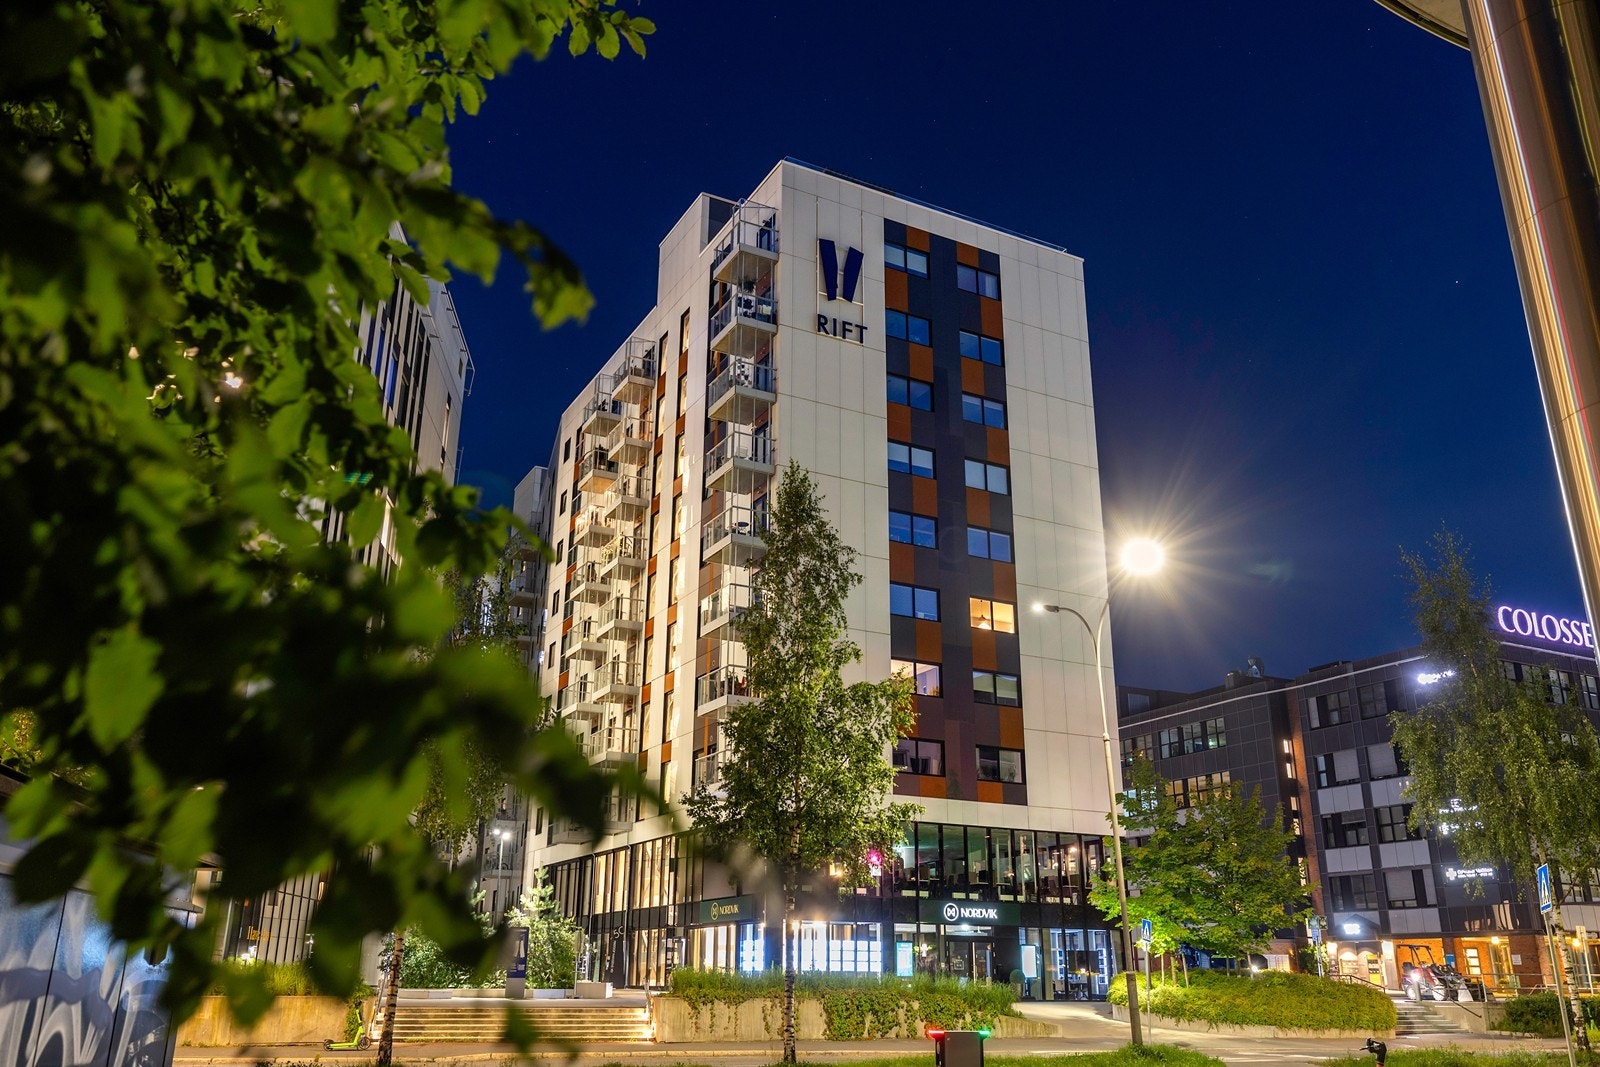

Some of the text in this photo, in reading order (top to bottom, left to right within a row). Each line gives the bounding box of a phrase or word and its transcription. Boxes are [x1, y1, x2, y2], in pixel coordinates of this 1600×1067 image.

[817, 313, 868, 344] RIFT
[1498, 605, 1595, 648] COLOSSE
[719, 904, 740, 915] NORDVIK
[960, 907, 998, 919] NORDVIK
